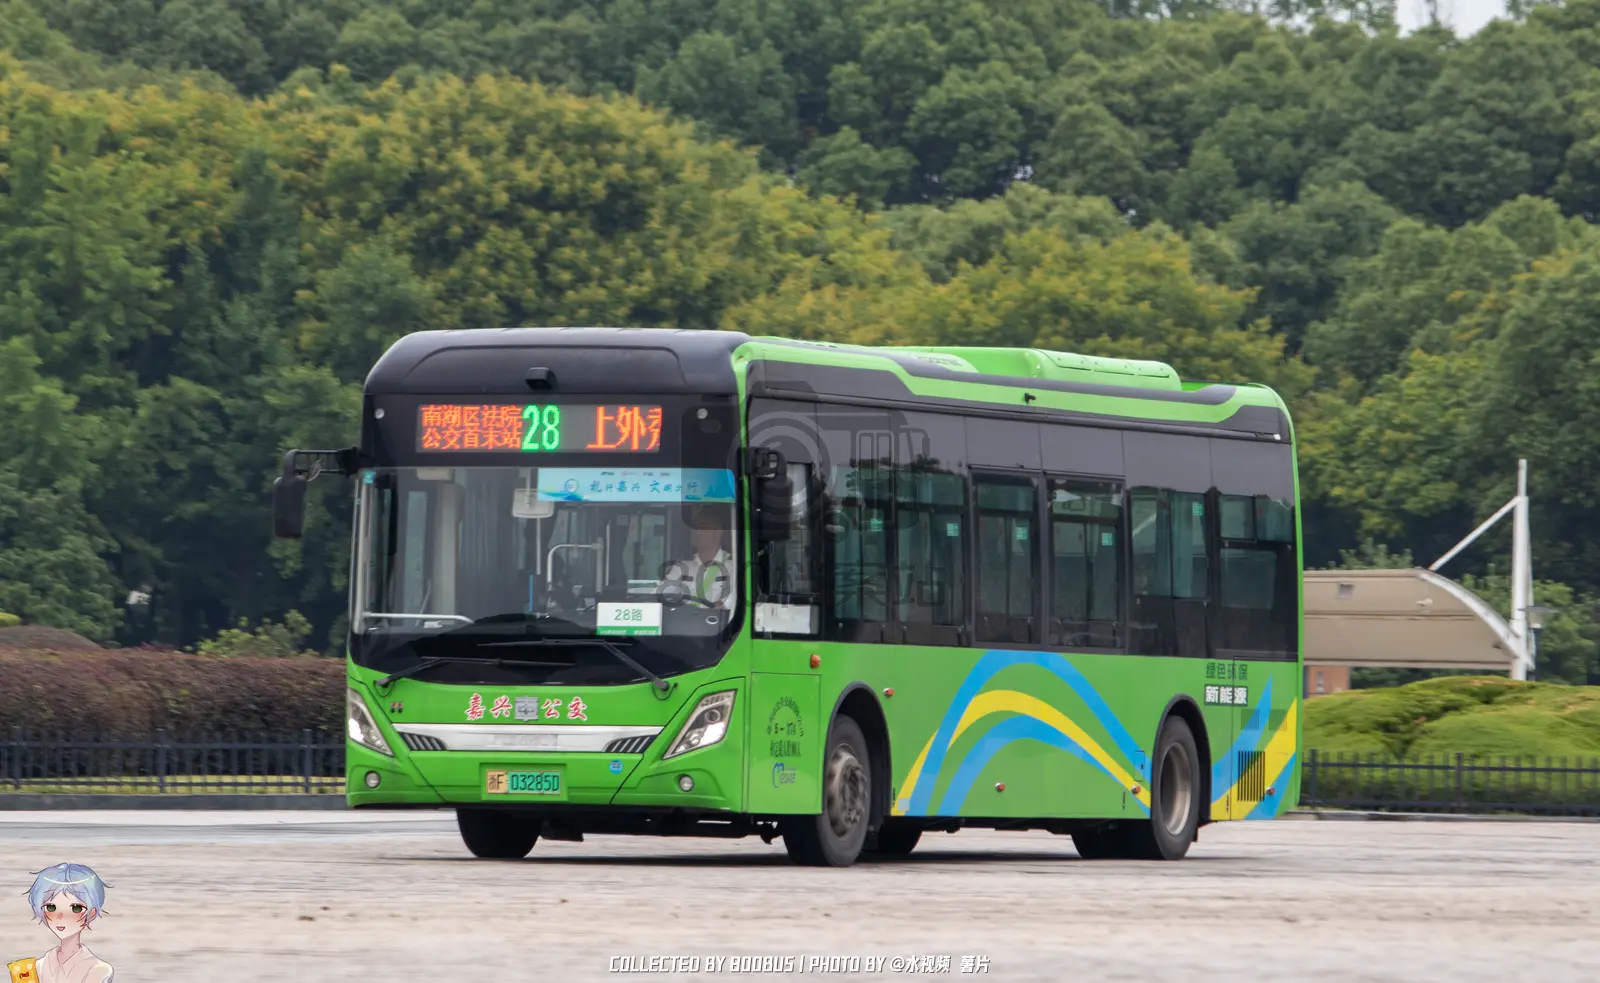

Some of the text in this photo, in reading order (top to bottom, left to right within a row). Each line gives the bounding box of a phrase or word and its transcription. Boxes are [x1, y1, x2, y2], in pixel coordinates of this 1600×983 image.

[420, 404, 523, 428] 南湖区法院
[521, 404, 560, 450] 28
[421, 427, 523, 450] 公交首末站
[613, 608, 643, 621] 28路
[1205, 662, 1248, 680] 绿色环保
[465, 692, 588, 721] 嘉兴 公交
[1205, 686, 1247, 704] 新能源
